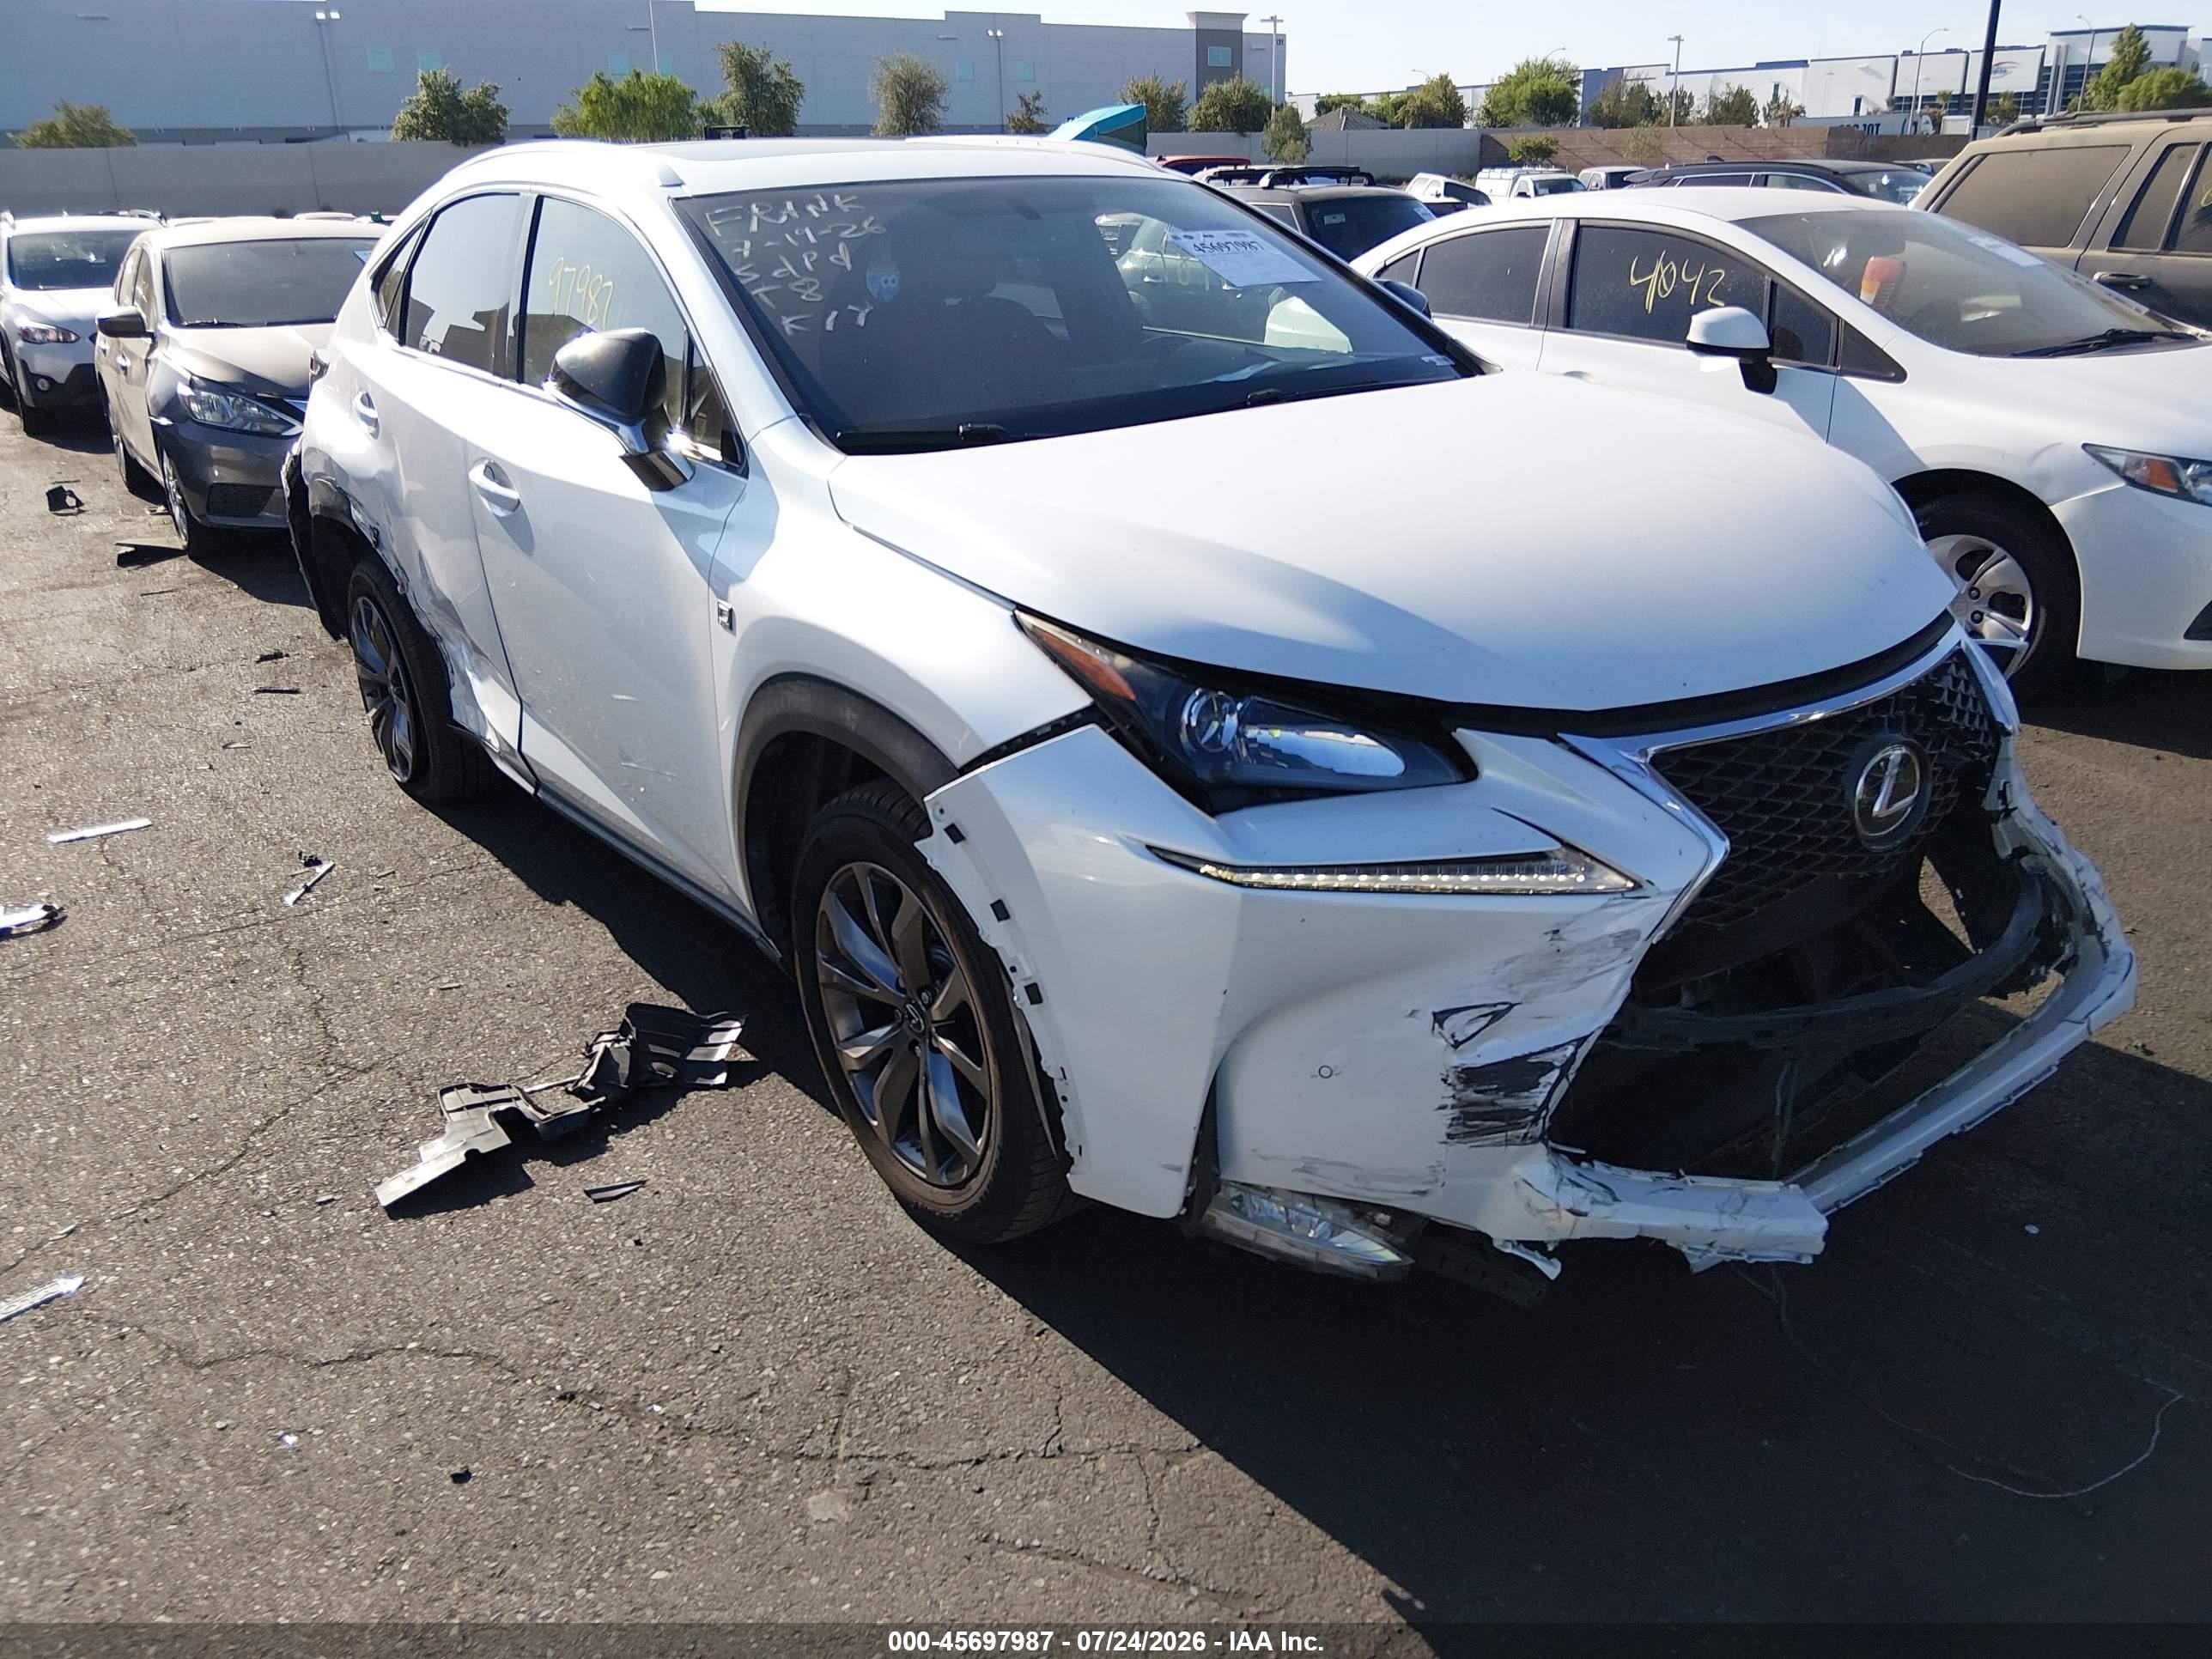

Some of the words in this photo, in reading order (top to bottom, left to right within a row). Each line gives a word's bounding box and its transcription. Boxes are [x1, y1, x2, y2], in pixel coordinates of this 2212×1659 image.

[705, 194, 865, 237] FRANK
[1193, 240, 1264, 254] 45697987
[549, 257, 613, 330] 97987
[1630, 248, 1725, 314] 4042
